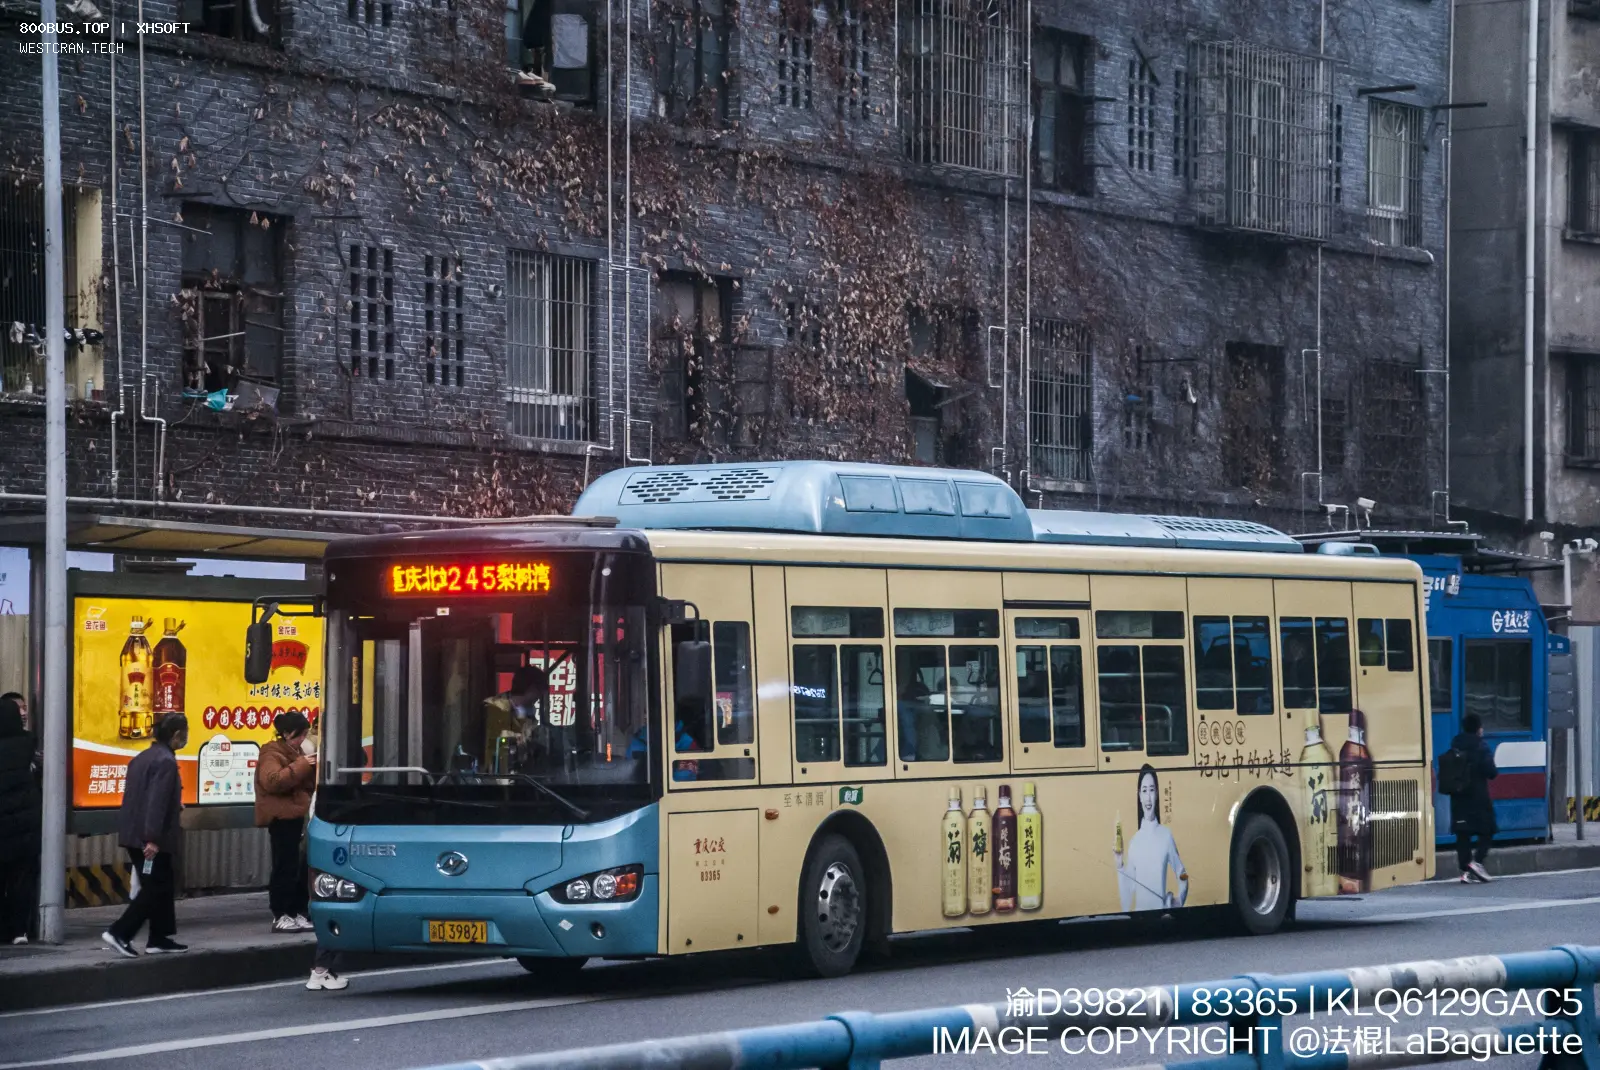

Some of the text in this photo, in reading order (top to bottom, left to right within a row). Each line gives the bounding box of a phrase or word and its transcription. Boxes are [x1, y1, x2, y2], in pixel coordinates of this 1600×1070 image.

[1198, 748, 1294, 782] 记忆中的味道
[350, 843, 397, 857] HIGER
[700, 869, 721, 882] 83365
